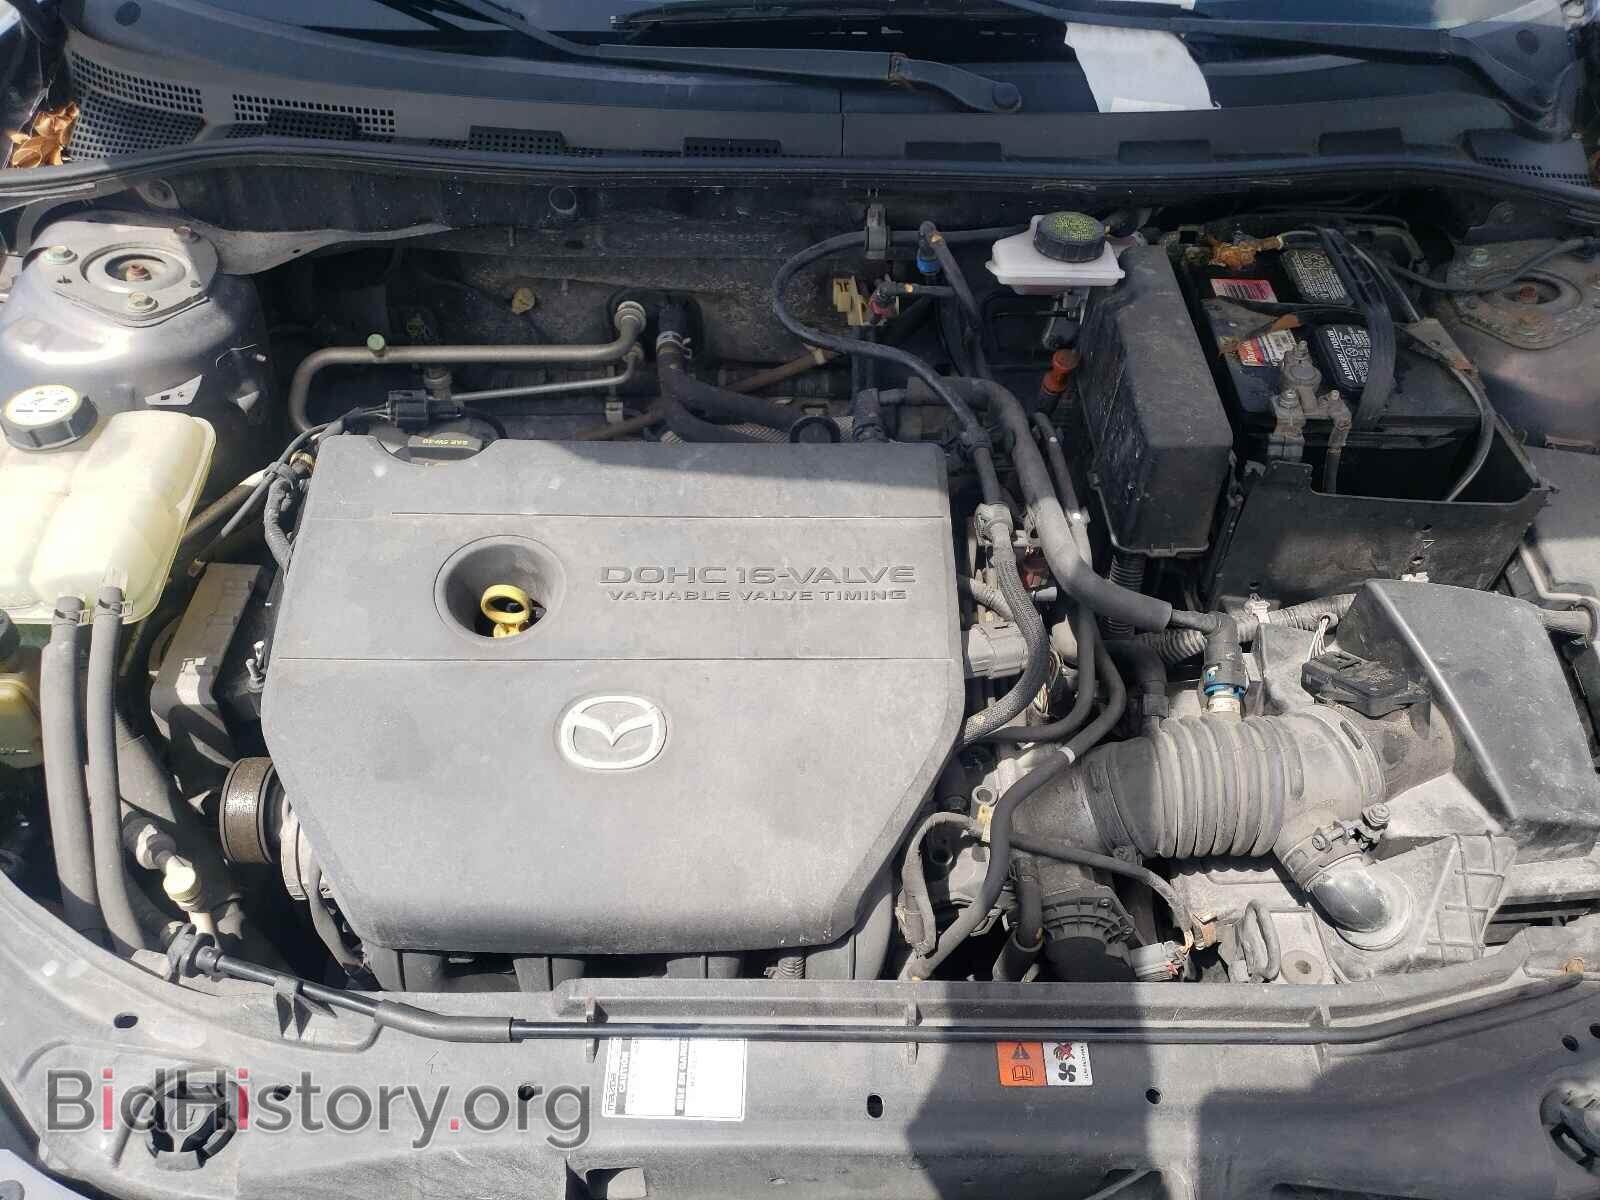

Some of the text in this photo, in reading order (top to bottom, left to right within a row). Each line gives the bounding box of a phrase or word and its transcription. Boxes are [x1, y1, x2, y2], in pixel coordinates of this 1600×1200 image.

[600, 566, 916, 584] DOHC 16-VALVE
[608, 590, 907, 601] VARIABLE VALVE TIMING
